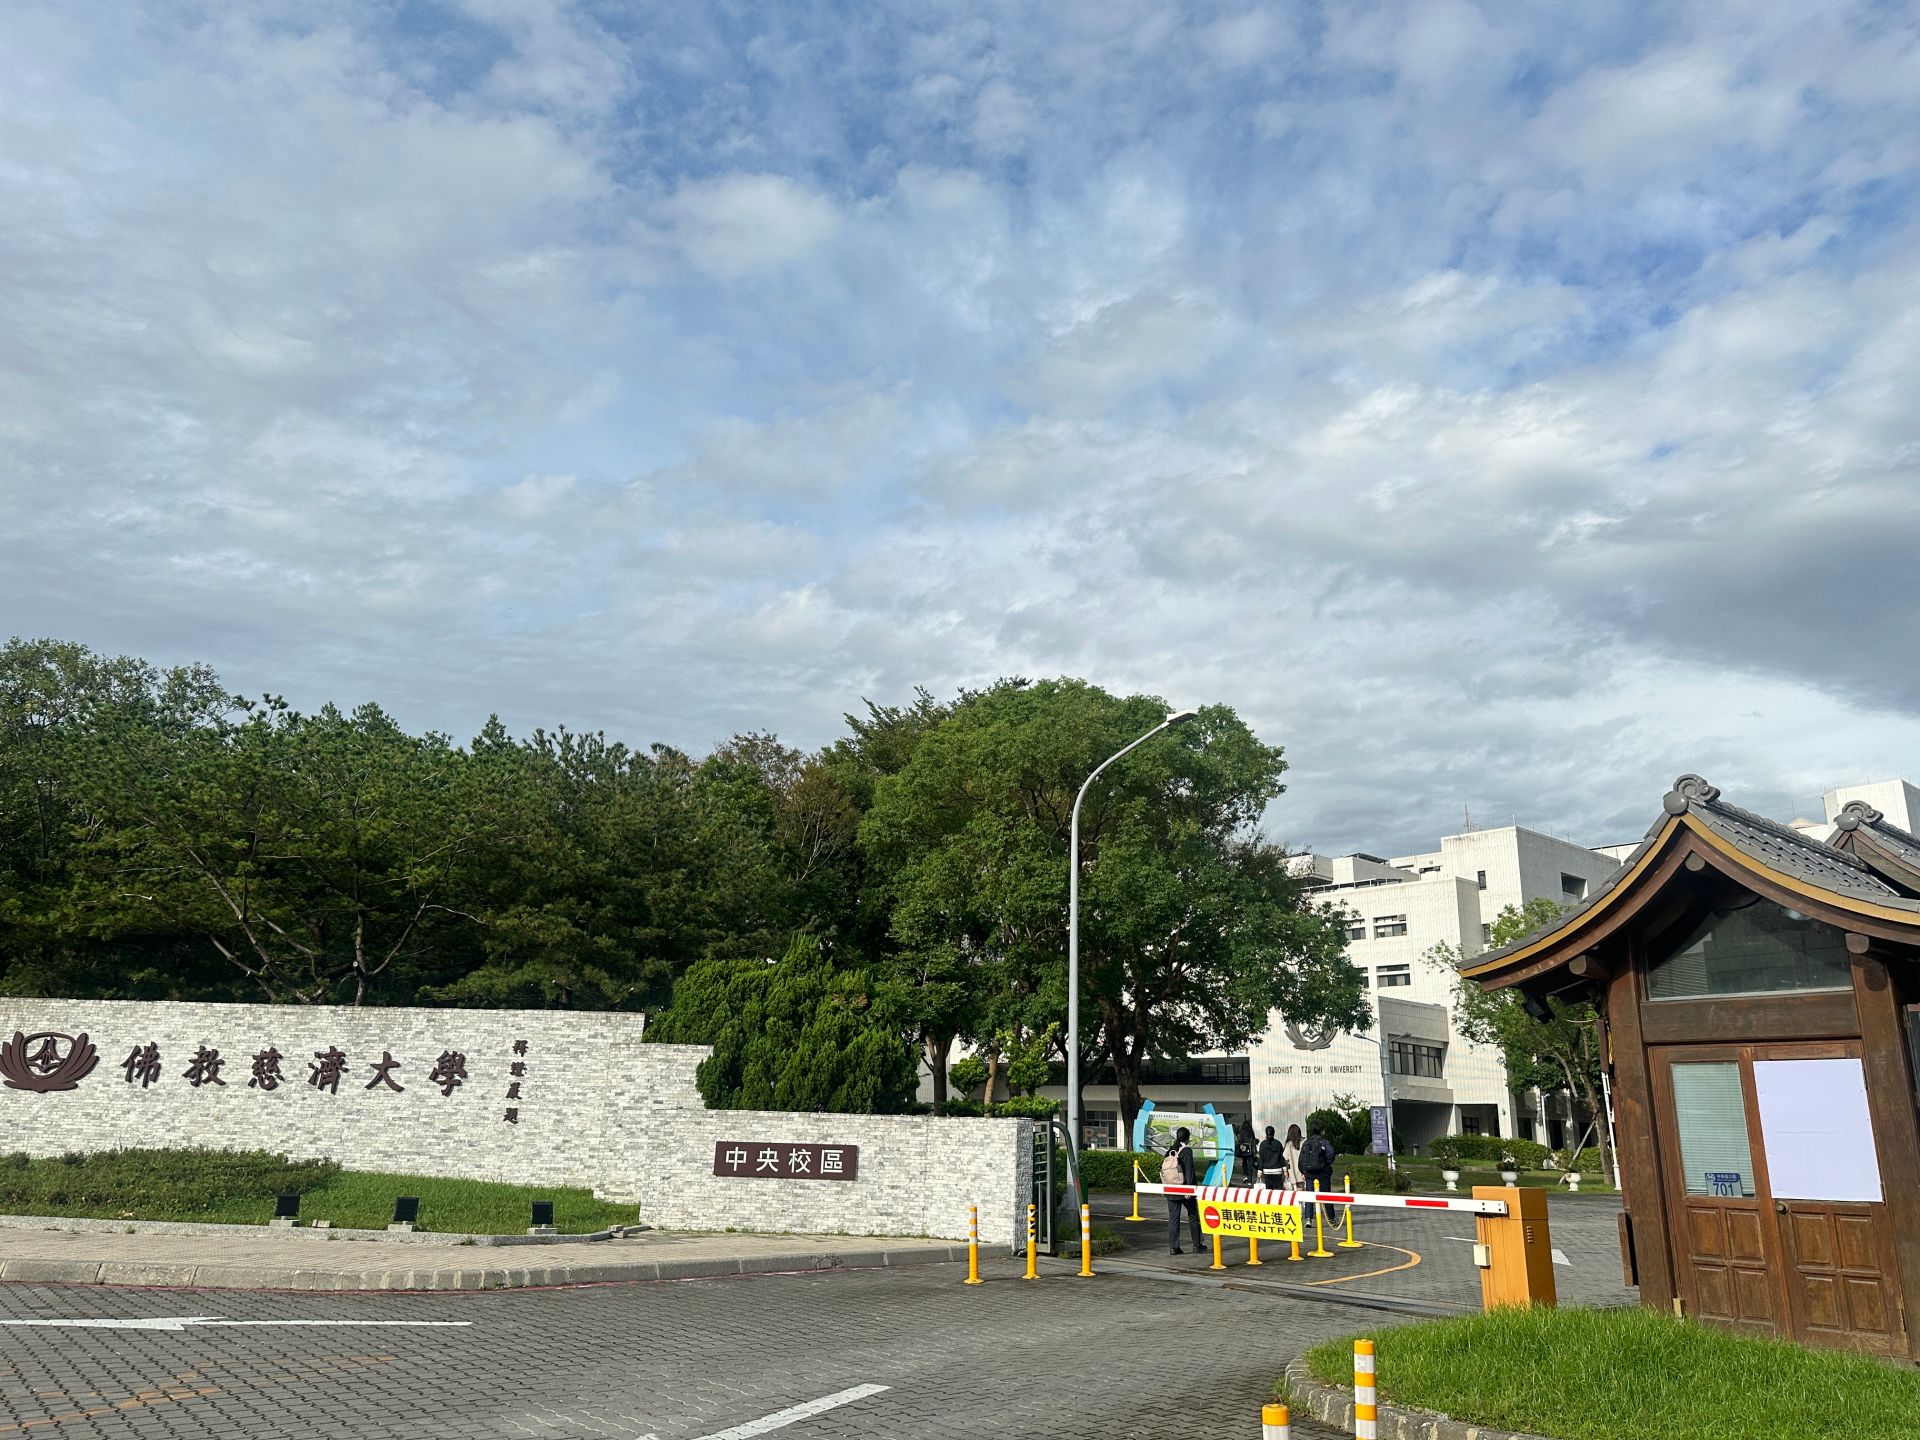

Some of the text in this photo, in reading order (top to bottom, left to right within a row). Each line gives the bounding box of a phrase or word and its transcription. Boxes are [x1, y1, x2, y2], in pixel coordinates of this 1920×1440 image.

[120, 1041, 470, 1097] 佛教慈濟大學
[1268, 1065, 1362, 1074] BUDDHIST TZU CHI UNIVERSITY
[725, 1146, 844, 1174] 中央校區
[1713, 1183, 1734, 1196] 701
[1221, 1208, 1297, 1227] 車輛禁止進入
[1223, 1223, 1297, 1235] NO ENTRY
